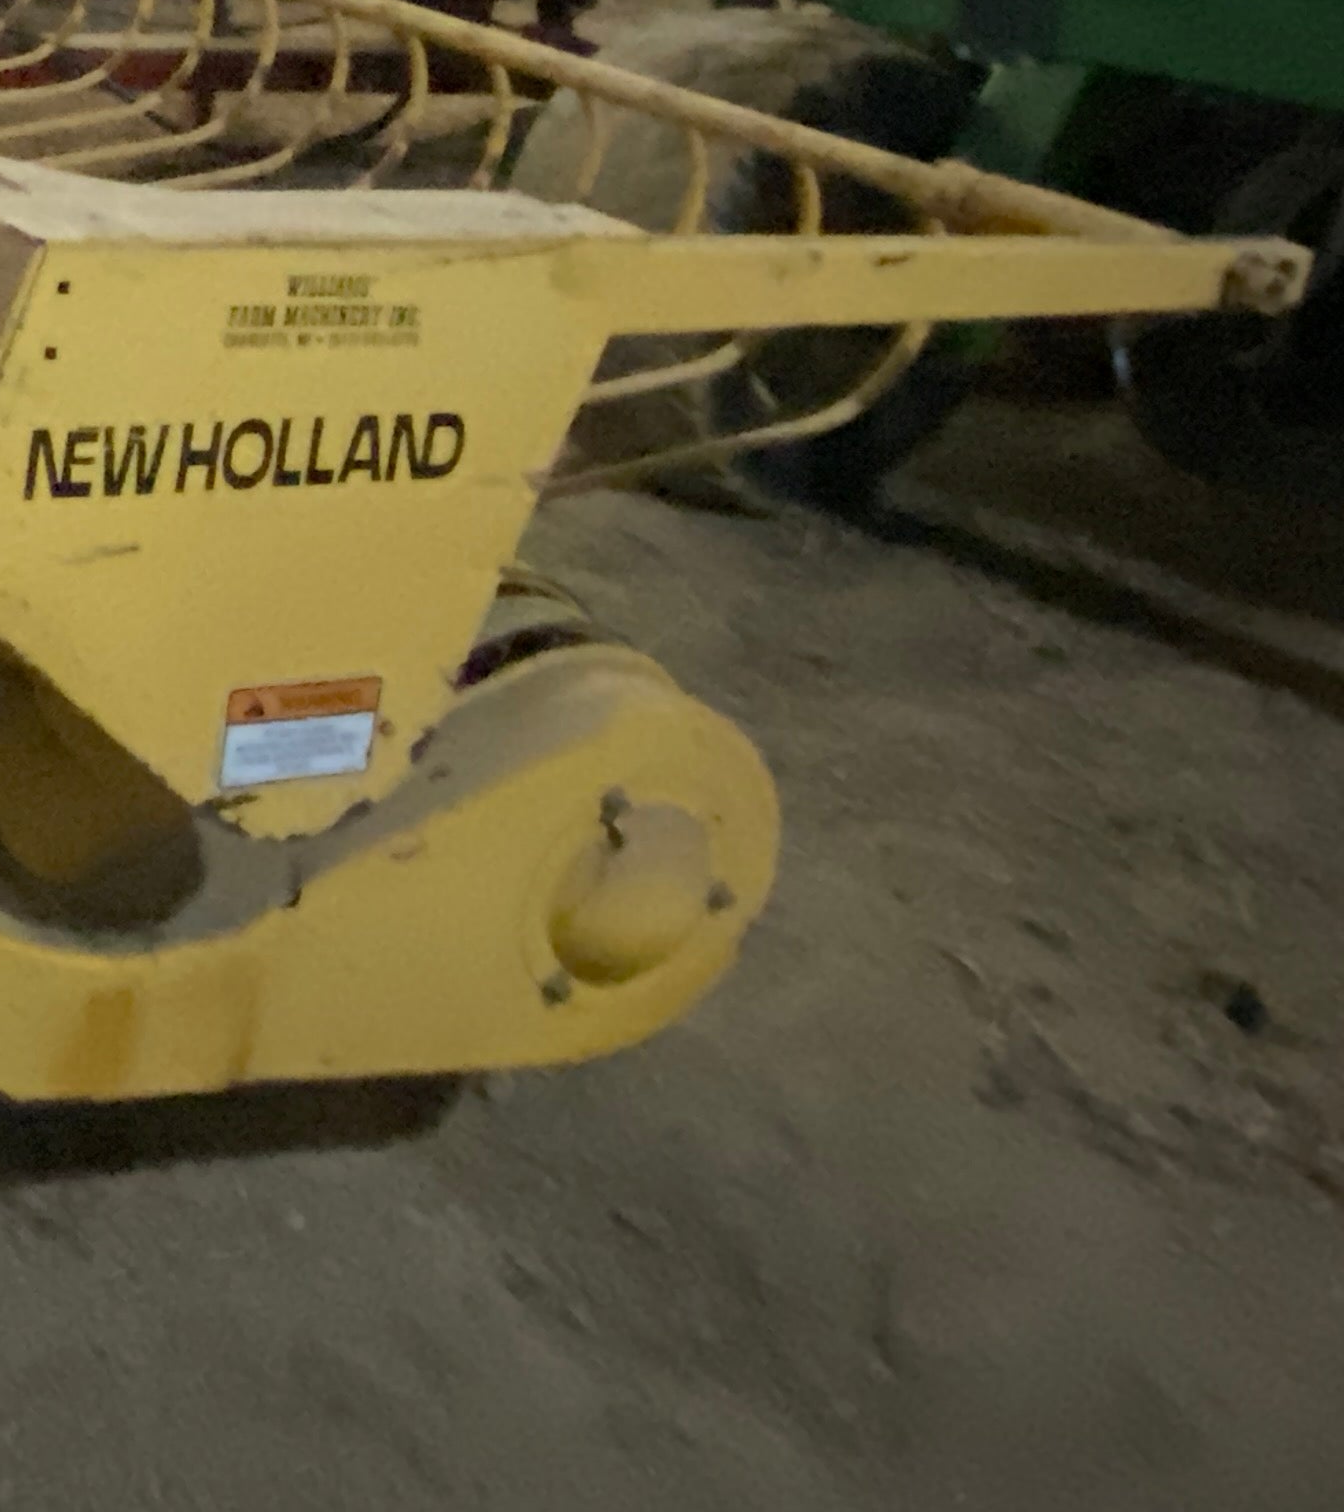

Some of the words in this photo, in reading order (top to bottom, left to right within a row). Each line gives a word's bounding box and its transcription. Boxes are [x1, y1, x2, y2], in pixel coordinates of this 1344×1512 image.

[226, 304, 277, 328] FARM
[283, 304, 385, 328] MACHINERY
[23, 424, 170, 501] NEW
[174, 412, 466, 492] HOLLAND
